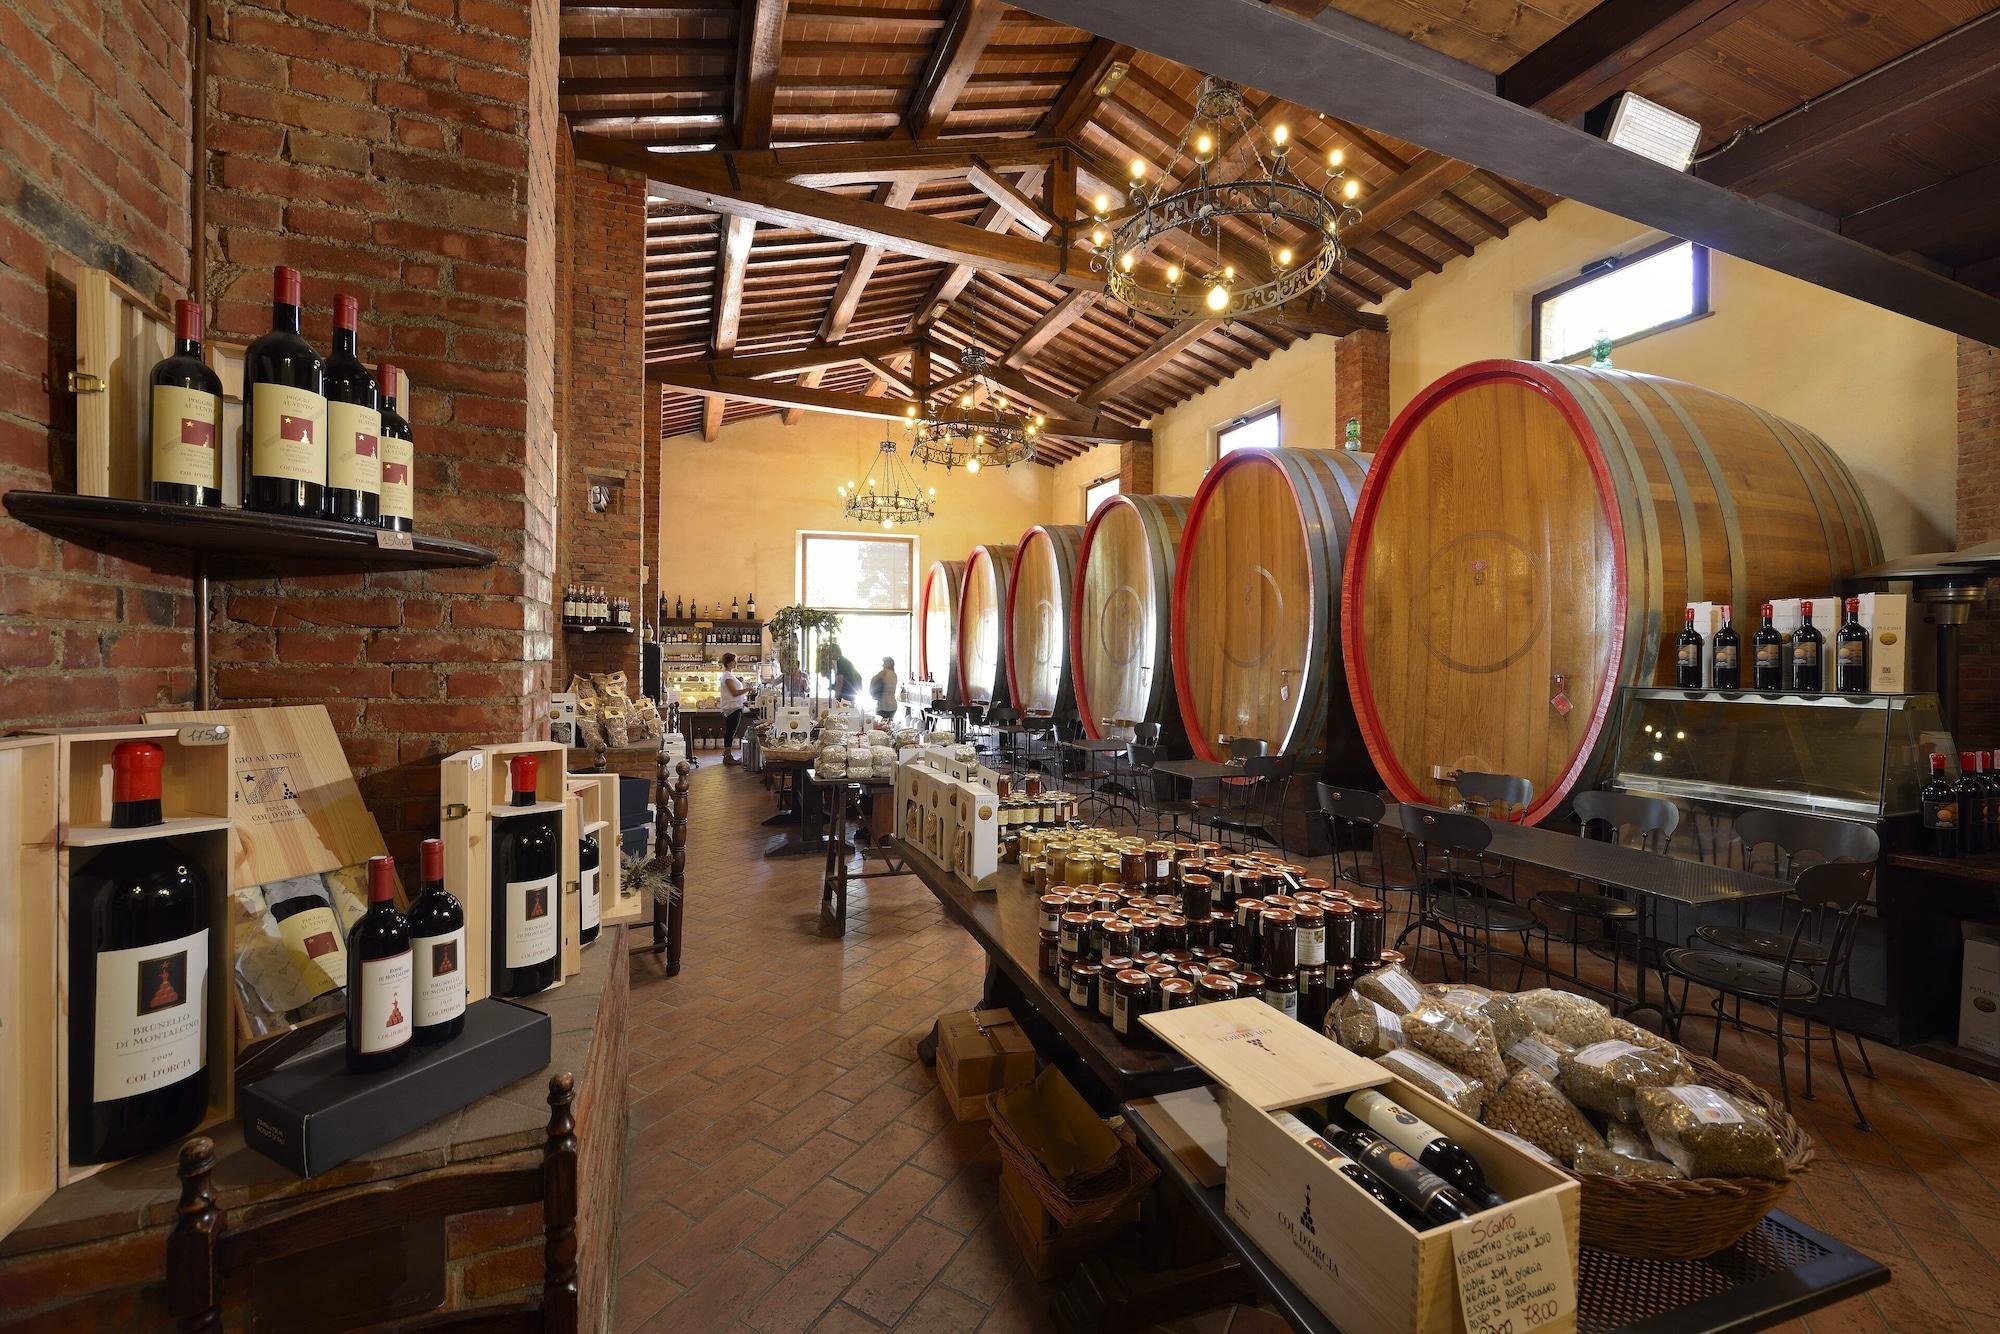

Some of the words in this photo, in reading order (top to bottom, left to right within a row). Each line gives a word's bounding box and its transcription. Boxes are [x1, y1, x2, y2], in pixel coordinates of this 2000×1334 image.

[234, 756, 252, 765] GIO
[254, 755, 269, 763] AL
[268, 751, 301, 761] VENTO
[251, 813, 272, 822] COL
[272, 807, 308, 819] D'ORCIA
[115, 1041, 129, 1050] DI
[133, 1018, 200, 1046] MONTALCINO
[133, 1012, 190, 1036] BRUNELLO
[152, 1051, 174, 1063] 2009
[126, 1073, 150, 1085] COL
[152, 1058, 192, 1079] D'ORCIA
[1278, 1211, 1297, 1237] COL
[1299, 1230, 1339, 1278] D'ORCIA
[1534, 1232, 1552, 1249] 2010
[1505, 1283, 1527, 1298] ROSSO
[1521, 1299, 1558, 1327] 78,00
